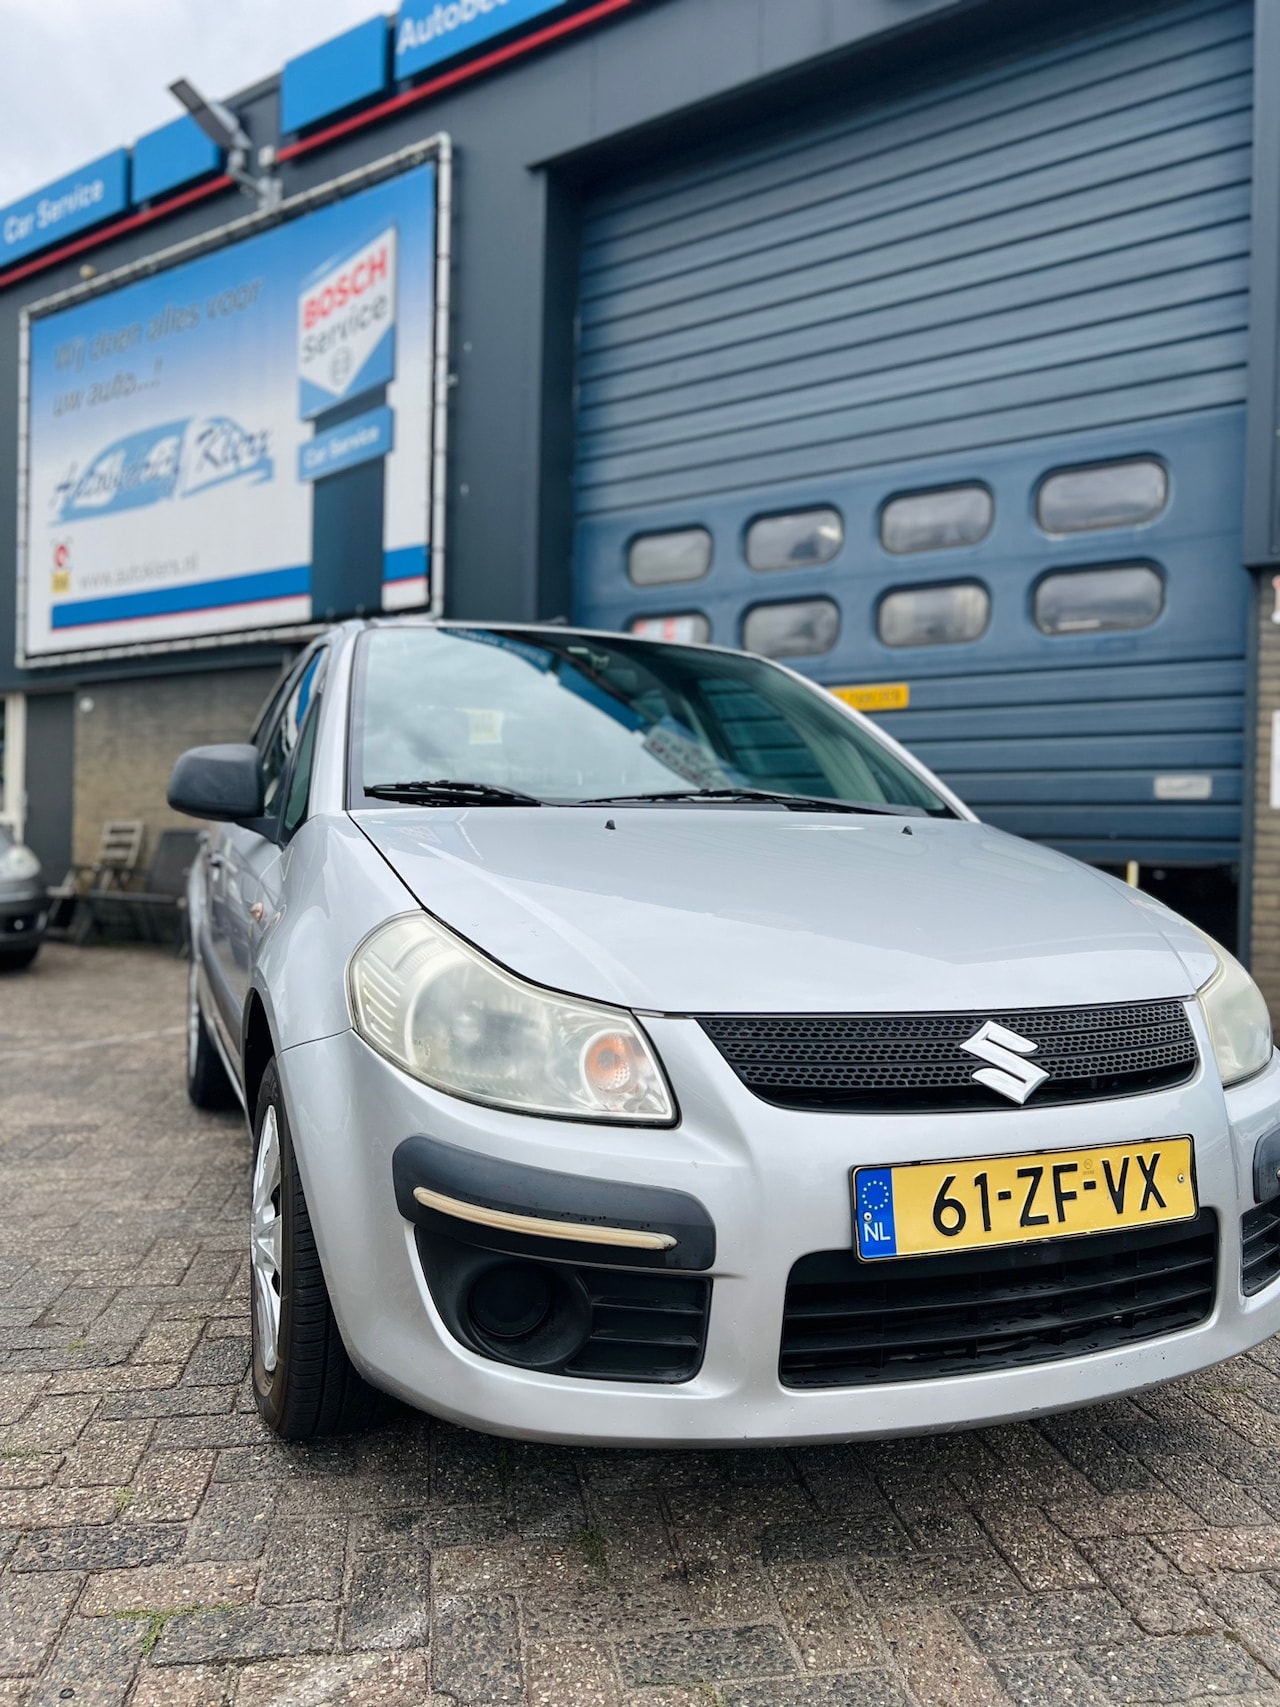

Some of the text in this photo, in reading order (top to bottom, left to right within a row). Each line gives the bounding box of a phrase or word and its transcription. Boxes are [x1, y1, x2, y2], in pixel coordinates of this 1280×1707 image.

[4, 178, 104, 244] Car Service
[147, 302, 201, 343] alles
[206, 277, 264, 320] voor
[303, 246, 387, 331] BOSCH
[302, 294, 388, 362] Service
[329, 425, 380, 460] Service
[932, 1153, 1167, 1237] 61-ZF-VX
[864, 1222, 892, 1242] NL
